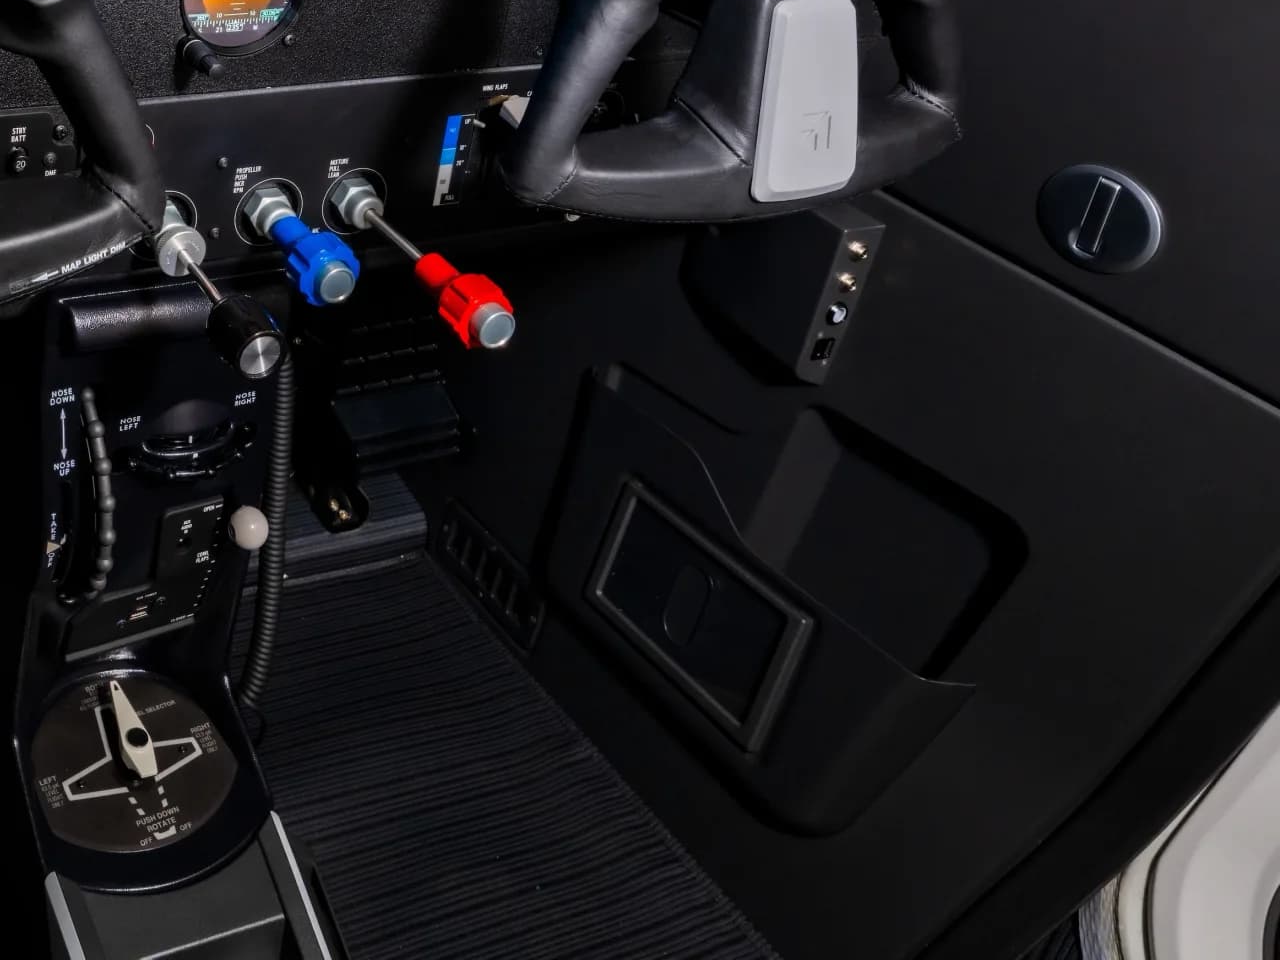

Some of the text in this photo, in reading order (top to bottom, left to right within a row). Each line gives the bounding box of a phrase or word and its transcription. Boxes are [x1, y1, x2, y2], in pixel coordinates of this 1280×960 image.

[61, 250, 108, 274] MAP LIGHT
[51, 388, 73, 398] NOSE
[234, 391, 256, 400] NOSE
[49, 394, 75, 406] DOWN
[234, 397, 256, 407] RIGHT
[120, 416, 141, 426] NOSE
[119, 422, 139, 432] LEFT
[54, 460, 76, 471] NOSE
[38, 775, 57, 786] LEFT
[135, 806, 180, 828] PUSH DOWN
[146, 816, 177, 832] ROTATE
